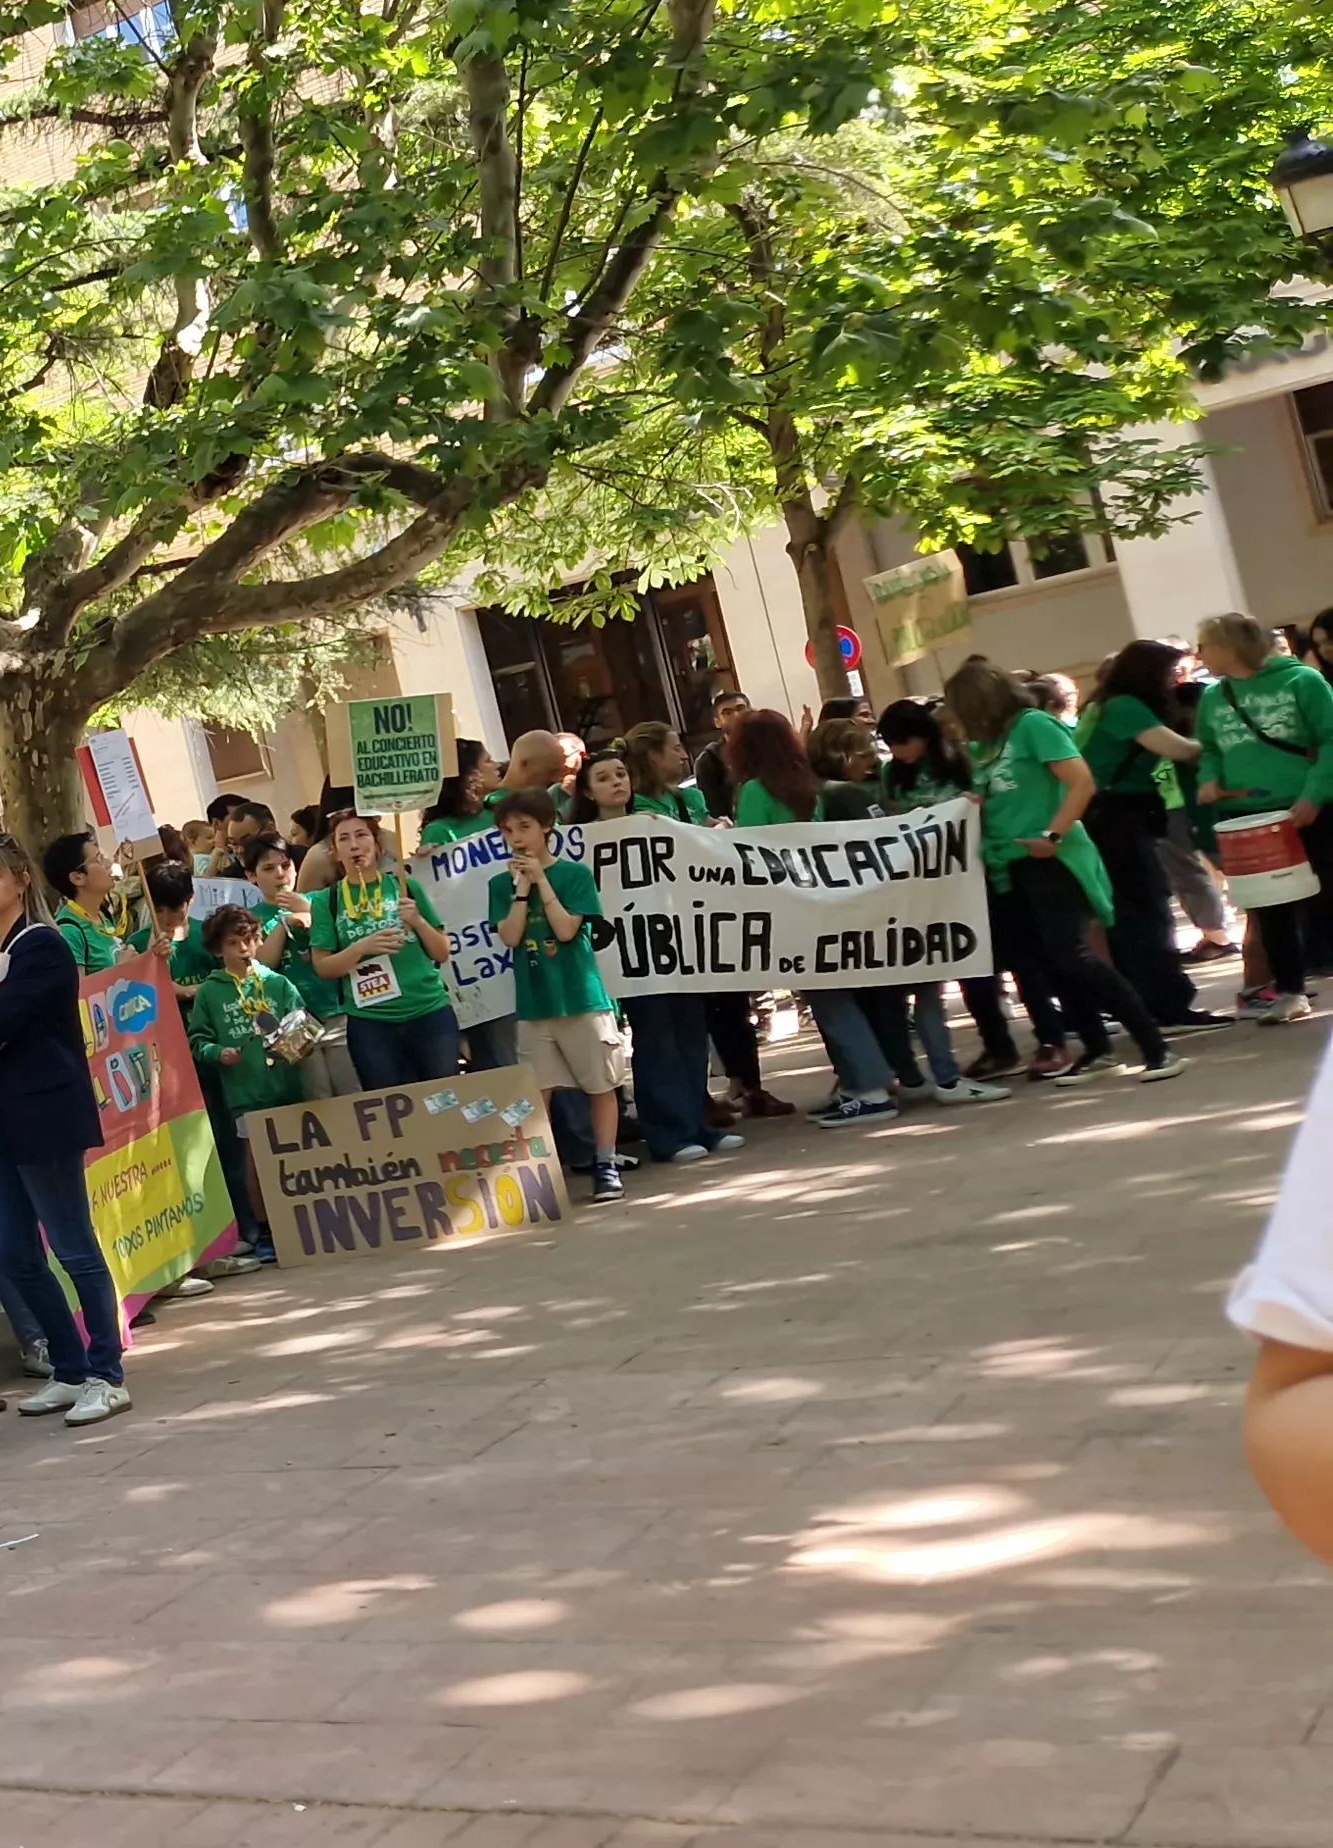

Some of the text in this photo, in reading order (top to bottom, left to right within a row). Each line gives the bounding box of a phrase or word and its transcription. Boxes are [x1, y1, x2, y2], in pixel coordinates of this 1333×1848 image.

[373, 703, 414, 735] NO!
[356, 734, 436, 755] AL CONCIERTO
[356, 751, 438, 772] EDUCATIVO EN
[356, 767, 439, 789] BACHILLERATO
[593, 815, 968, 890] POR UNA EDUCACIÓN
[346, 926, 364, 940] DE
[591, 901, 979, 979] PÚBLICA DE CALIDAD
[359, 976, 388, 992] STEA
[265, 1093, 414, 1155] LA FP
[279, 1126, 552, 1197] también necesita
[113, 1192, 205, 1261] TODOS PINTAMOS
[293, 1163, 562, 1255] INVERSIÓN
